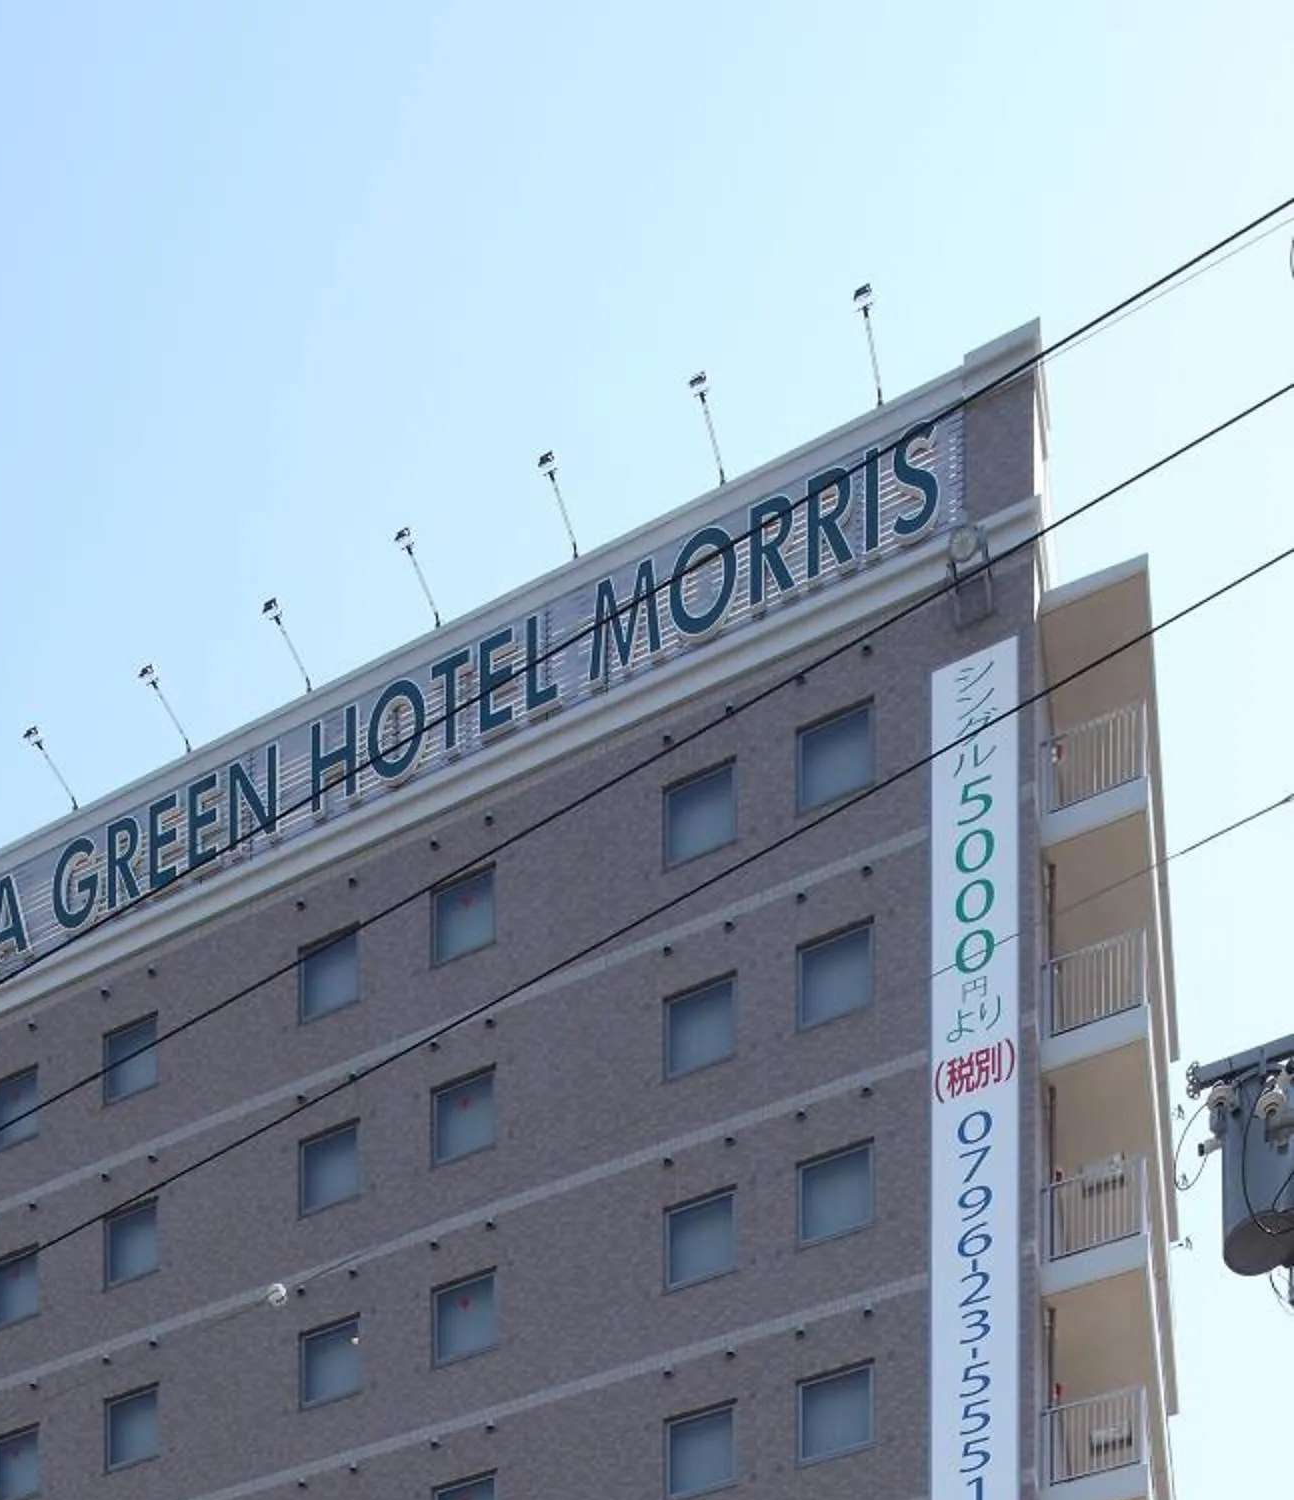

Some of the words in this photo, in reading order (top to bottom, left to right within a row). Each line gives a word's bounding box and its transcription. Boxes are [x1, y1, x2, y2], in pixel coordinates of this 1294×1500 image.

[53, 741, 281, 930] GREEN
[310, 613, 559, 813] HOTEL
[588, 421, 940, 682] MORRIS
